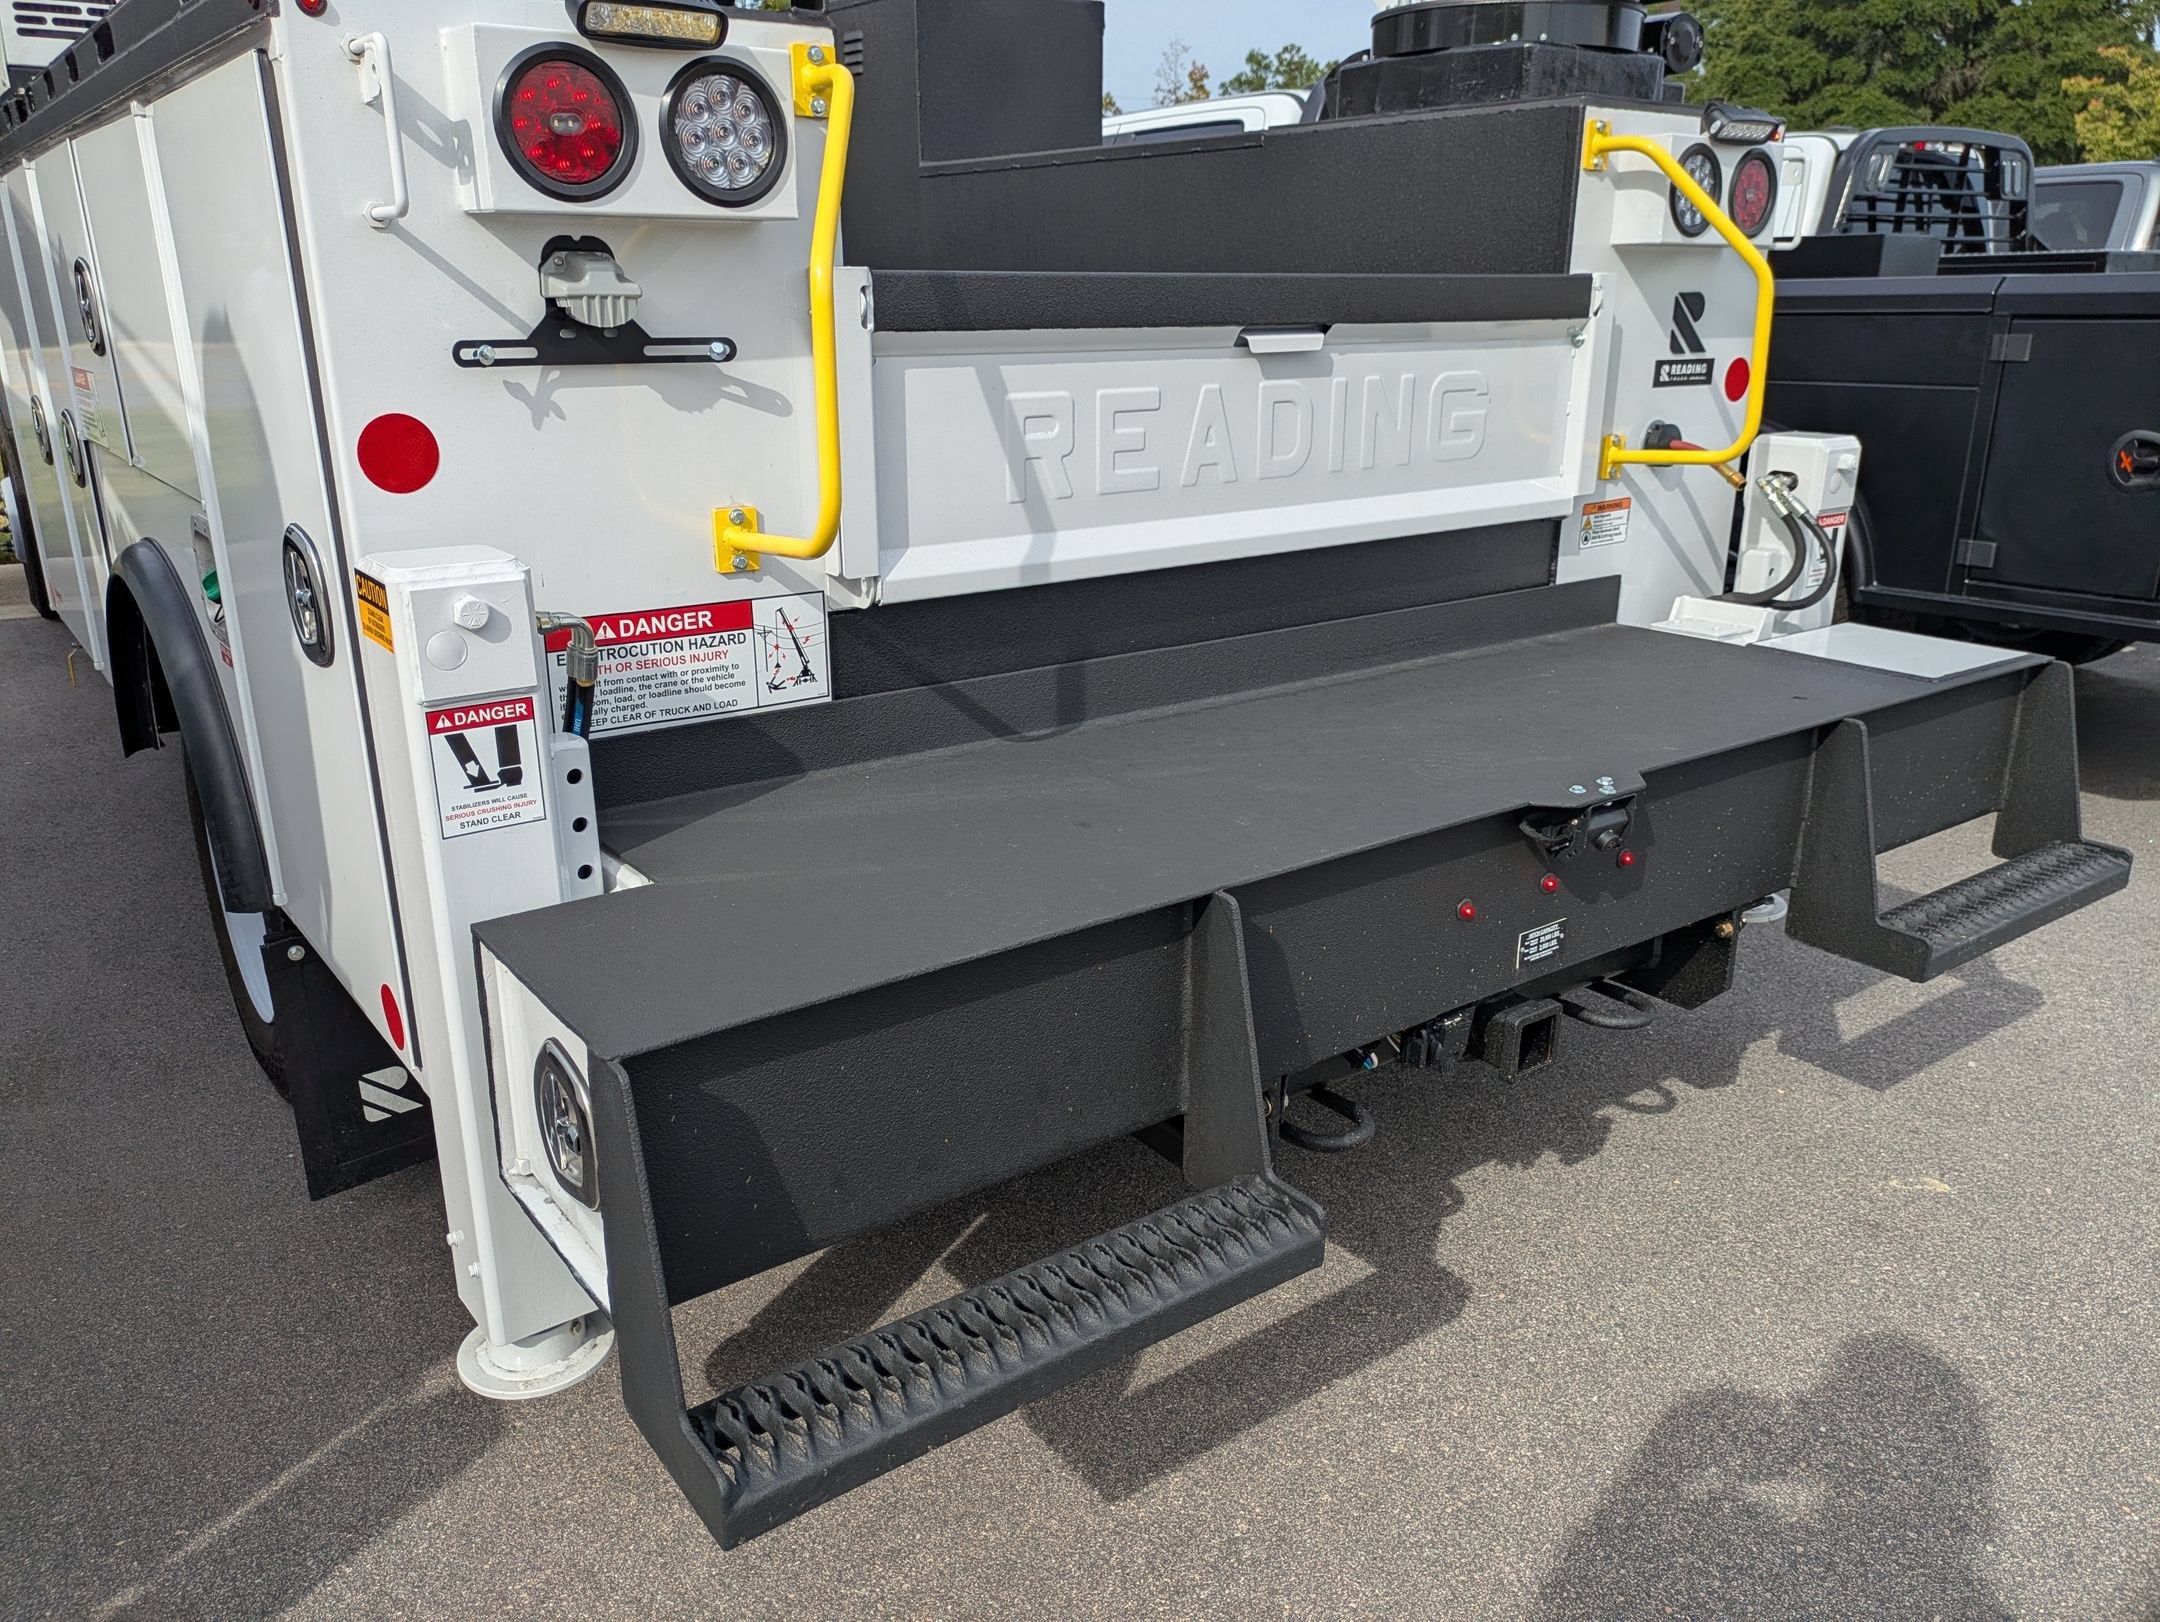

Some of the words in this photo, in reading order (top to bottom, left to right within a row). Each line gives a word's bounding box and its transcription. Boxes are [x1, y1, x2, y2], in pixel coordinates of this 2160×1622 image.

[1671, 362, 1708, 375] READING
[1005, 370, 1490, 504] READING
[1597, 501, 1623, 511] WARNING
[356, 574, 387, 610] CAUTION
[619, 610, 714, 638] DANGER
[557, 639, 684, 667] ETROCUTION
[688, 632, 747, 651] HAZARD
[615, 661, 633, 672] OR
[635, 655, 687, 670] SERIOUS
[689, 650, 729, 664] INJURY
[600, 685, 637, 697] loadline,
[638, 683, 652, 691] the
[654, 680, 678, 689] crane
[691, 676, 705, 684] the
[706, 672, 735, 682] vehicle
[603, 678, 624, 687] from
[626, 673, 659, 683] contact
[660, 670, 678, 679] with
[691, 664, 730, 677] proximity
[614, 694, 636, 703] load,
[637, 693, 647, 701] or
[648, 689, 682, 698] loadline
[684, 683, 713, 695] should
[714, 680, 746, 690] become
[454, 703, 528, 726] DANGER
[590, 717, 608, 727] EEP
[610, 712, 642, 724] CLEAR
[644, 710, 657, 719] OF
[659, 705, 691, 717] TRUCK
[692, 702, 712, 712] AND
[713, 699, 738, 710] LOAD
[610, 701, 649, 713] charged.
[445, 811, 476, 822] SERIOUS
[477, 803, 513, 816] CRUSHING
[514, 799, 537, 809] INJURY
[451, 800, 490, 812] STABILIZERS
[507, 793, 528, 801] CAUSE
[459, 817, 490, 829] STAND
[491, 811, 521, 823] CLEAR
